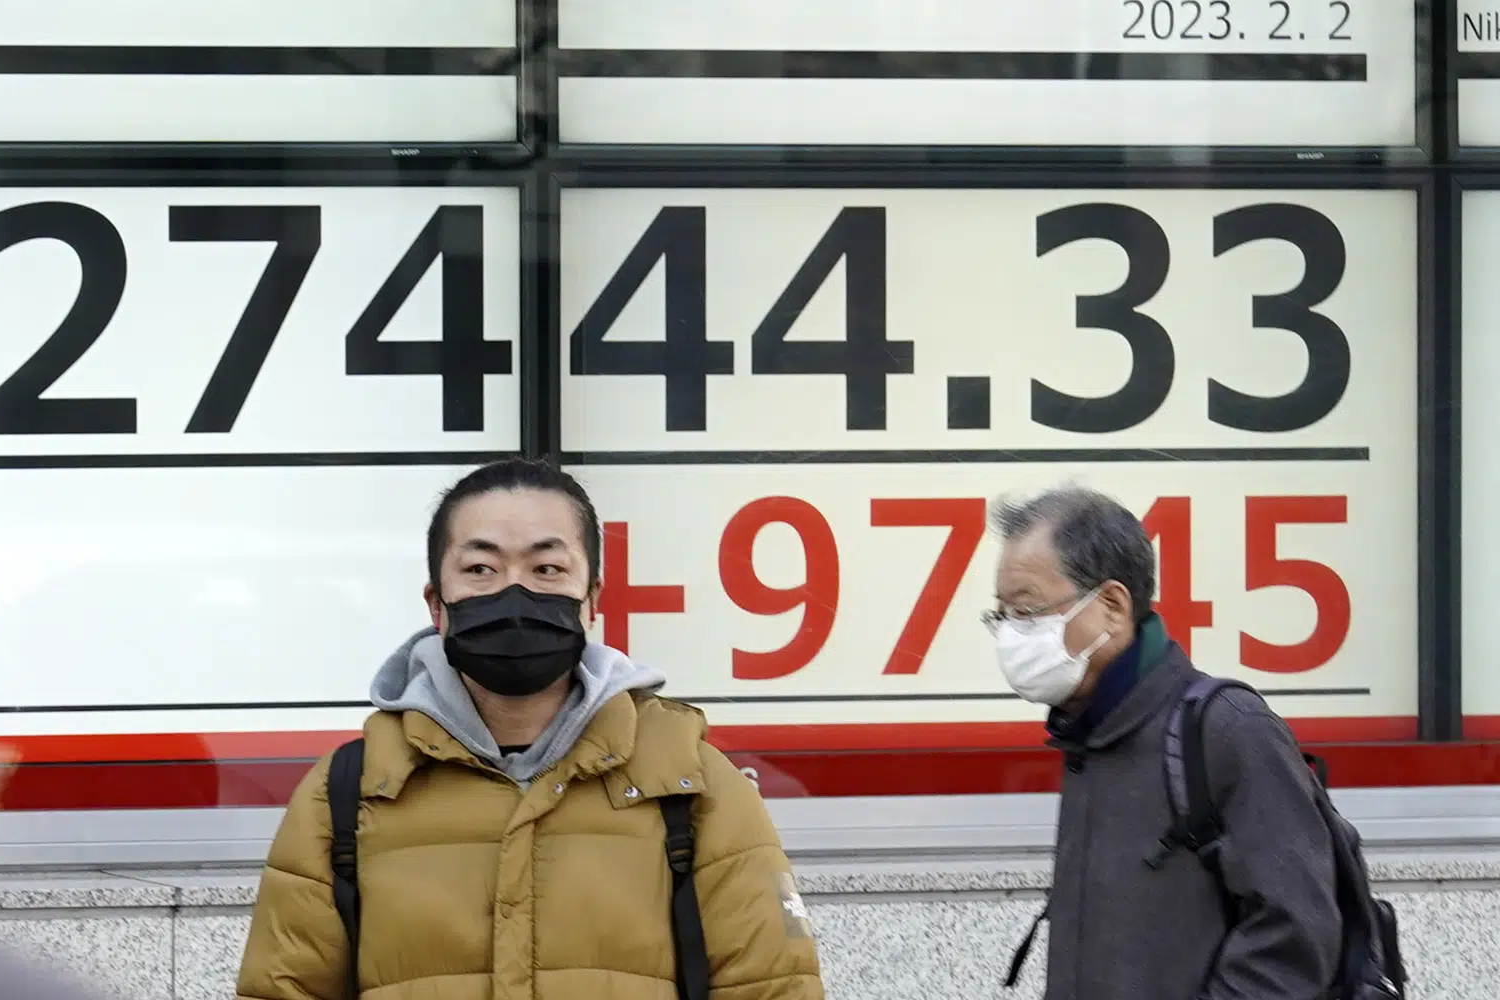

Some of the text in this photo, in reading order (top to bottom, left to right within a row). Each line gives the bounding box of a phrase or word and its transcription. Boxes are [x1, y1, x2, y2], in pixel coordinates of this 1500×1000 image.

[1122, 1, 1352, 40] 2023. 2. 2
